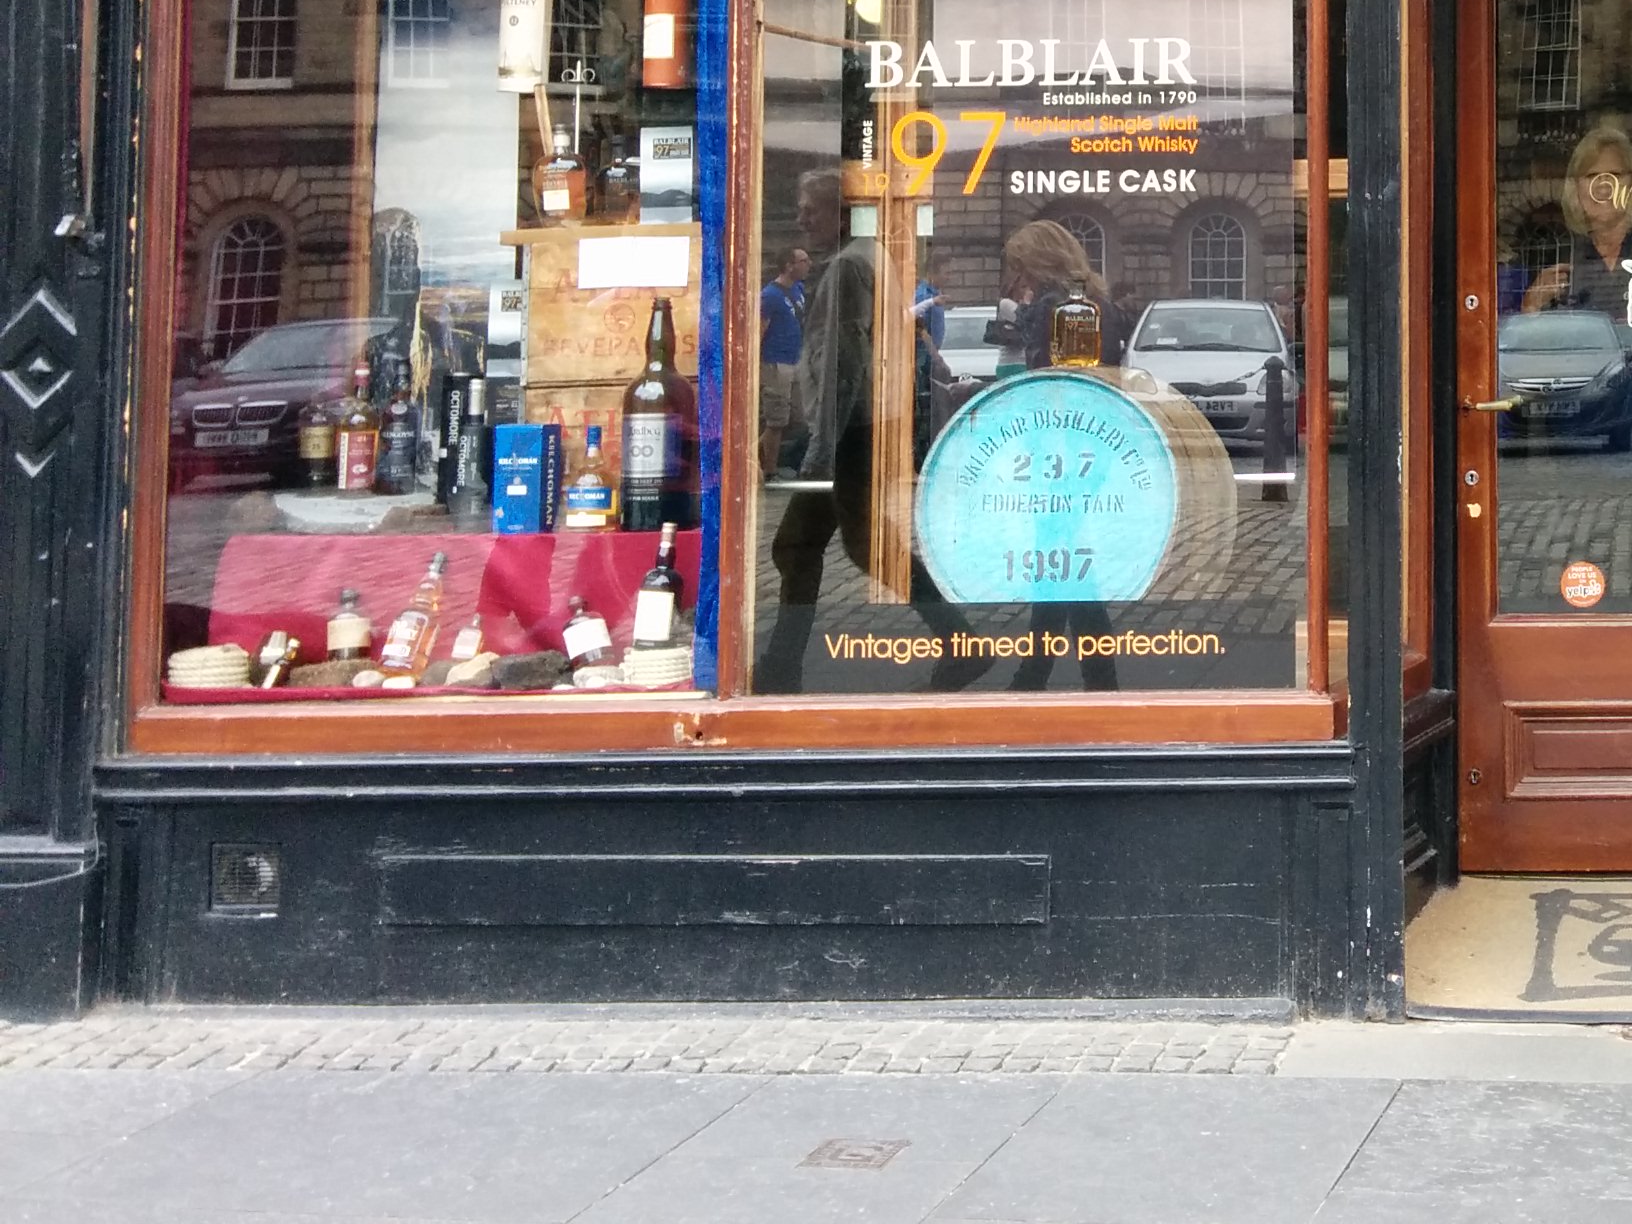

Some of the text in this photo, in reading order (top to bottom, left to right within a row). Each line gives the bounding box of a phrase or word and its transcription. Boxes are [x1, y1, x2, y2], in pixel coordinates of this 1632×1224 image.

[864, 36, 1198, 88] BALBLAIR
[1043, 90, 1198, 106] Established in 1790
[1099, 115, 1153, 137] Single
[1158, 115, 1198, 132] Malt
[861, 119, 873, 170] VINTAGE
[1070, 136, 1199, 155] Scotch Whisky
[1010, 169, 1197, 194] SINGLE CASK
[448, 390, 460, 446] OCTOMORE
[456, 435, 468, 487] OCTOMORE
[982, 494, 1125, 513] EDDERTON TAIN
[1003, 547, 1096, 583] 1997
[1566, 585, 1590, 598] yelp
[825, 632, 943, 664] Vintages
[950, 630, 1034, 659] timed
[1040, 630, 1070, 657] to
